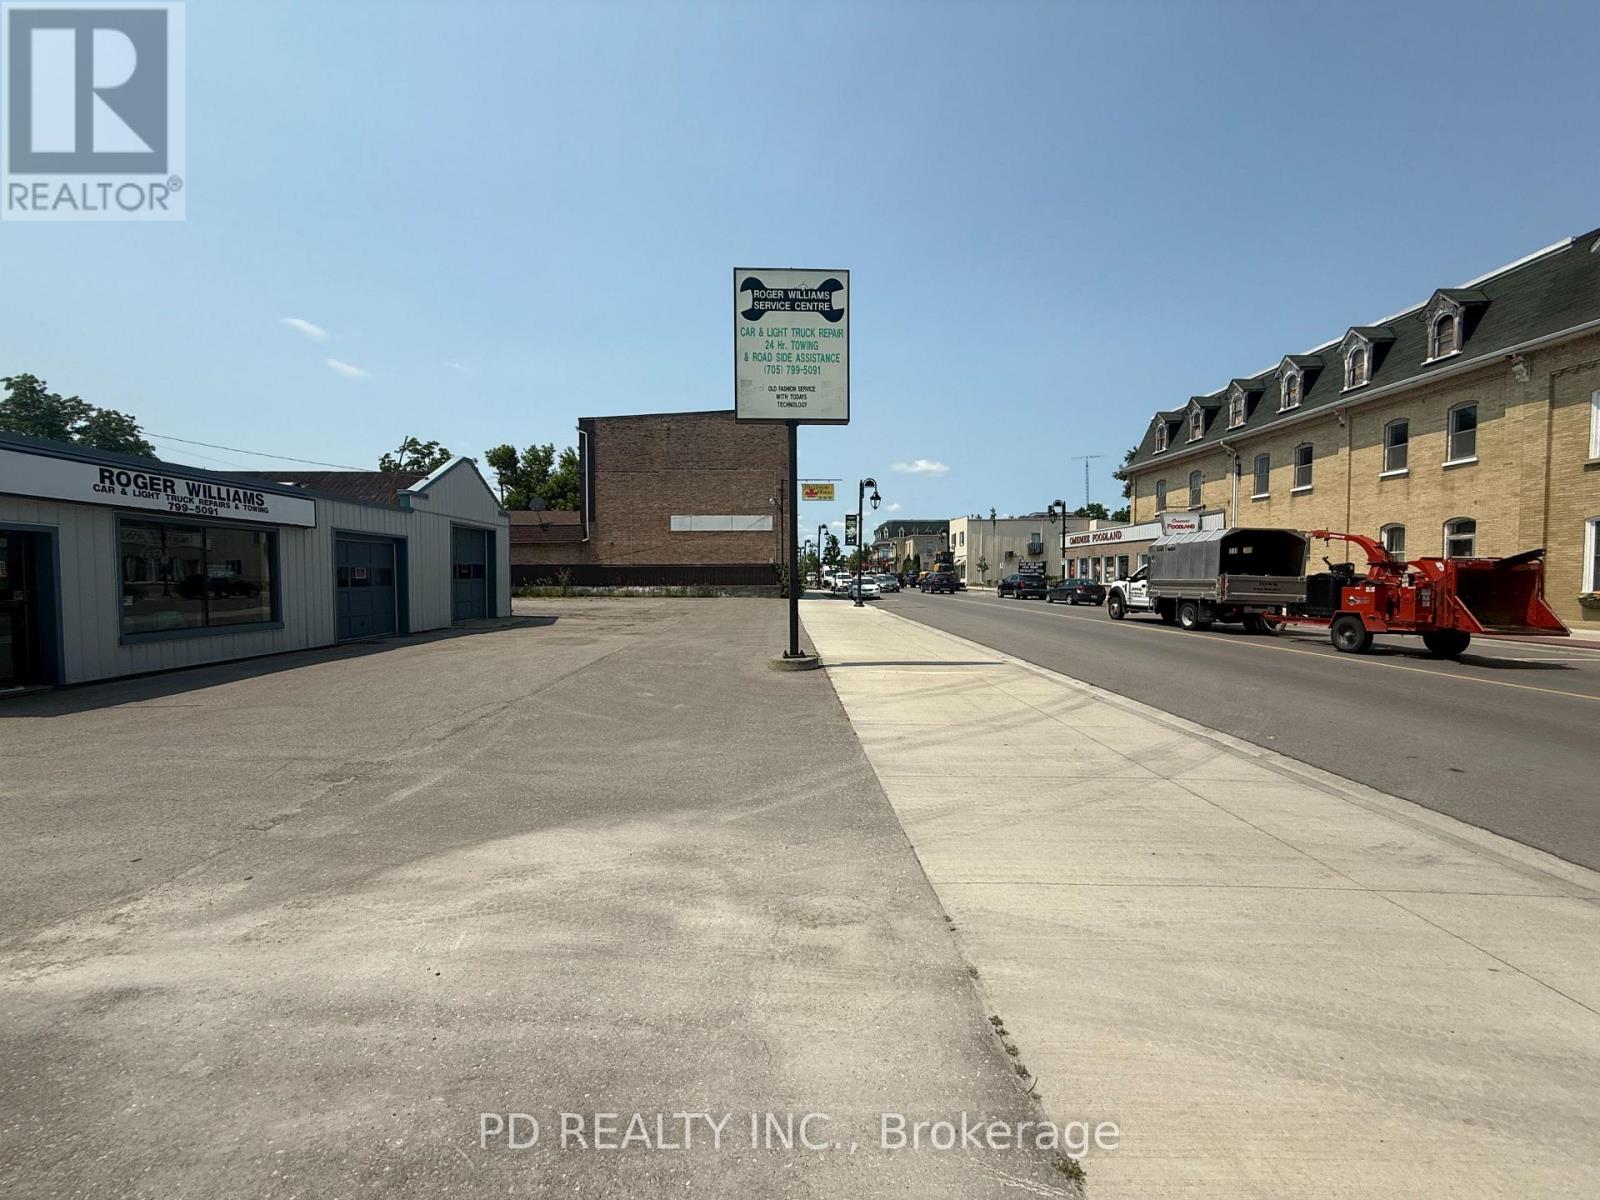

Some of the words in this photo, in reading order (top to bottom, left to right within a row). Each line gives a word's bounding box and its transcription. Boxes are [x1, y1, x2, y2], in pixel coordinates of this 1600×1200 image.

[753, 290, 784, 299] ROGER
[788, 290, 830, 300] WILLIAMS
[753, 301, 791, 310] SERVICE
[794, 301, 831, 311] CENTRE
[740, 327, 756, 337] CAR
[758, 327, 764, 337] &
[767, 327, 788, 338] LIGHT
[791, 328, 816, 338] TRUCK
[818, 328, 844, 339] REPAIR
[765, 340, 774, 350] 24
[777, 340, 787, 350] Hr.
[791, 341, 819, 350] TOWING
[744, 352, 749, 362] &
[752, 352, 773, 362] ROAD
[776, 353, 792, 363] SIDE
[796, 353, 841, 363] ASSISTANCE
[763, 365, 784, 375] (705)
[786, 365, 821, 375] 799-5091
[99, 467, 176, 494] ROGER
[185, 481, 265, 507] WILLIAMS
[93, 483, 115, 494] CAR
[120, 488, 128, 496] &
[132, 489, 160, 500] LIGHT
[165, 493, 194, 504] TRUCK
[198, 498, 231, 509] REPAIRS
[243, 504, 269, 514] TOWING
[167, 501, 219, 516] 799-5091
